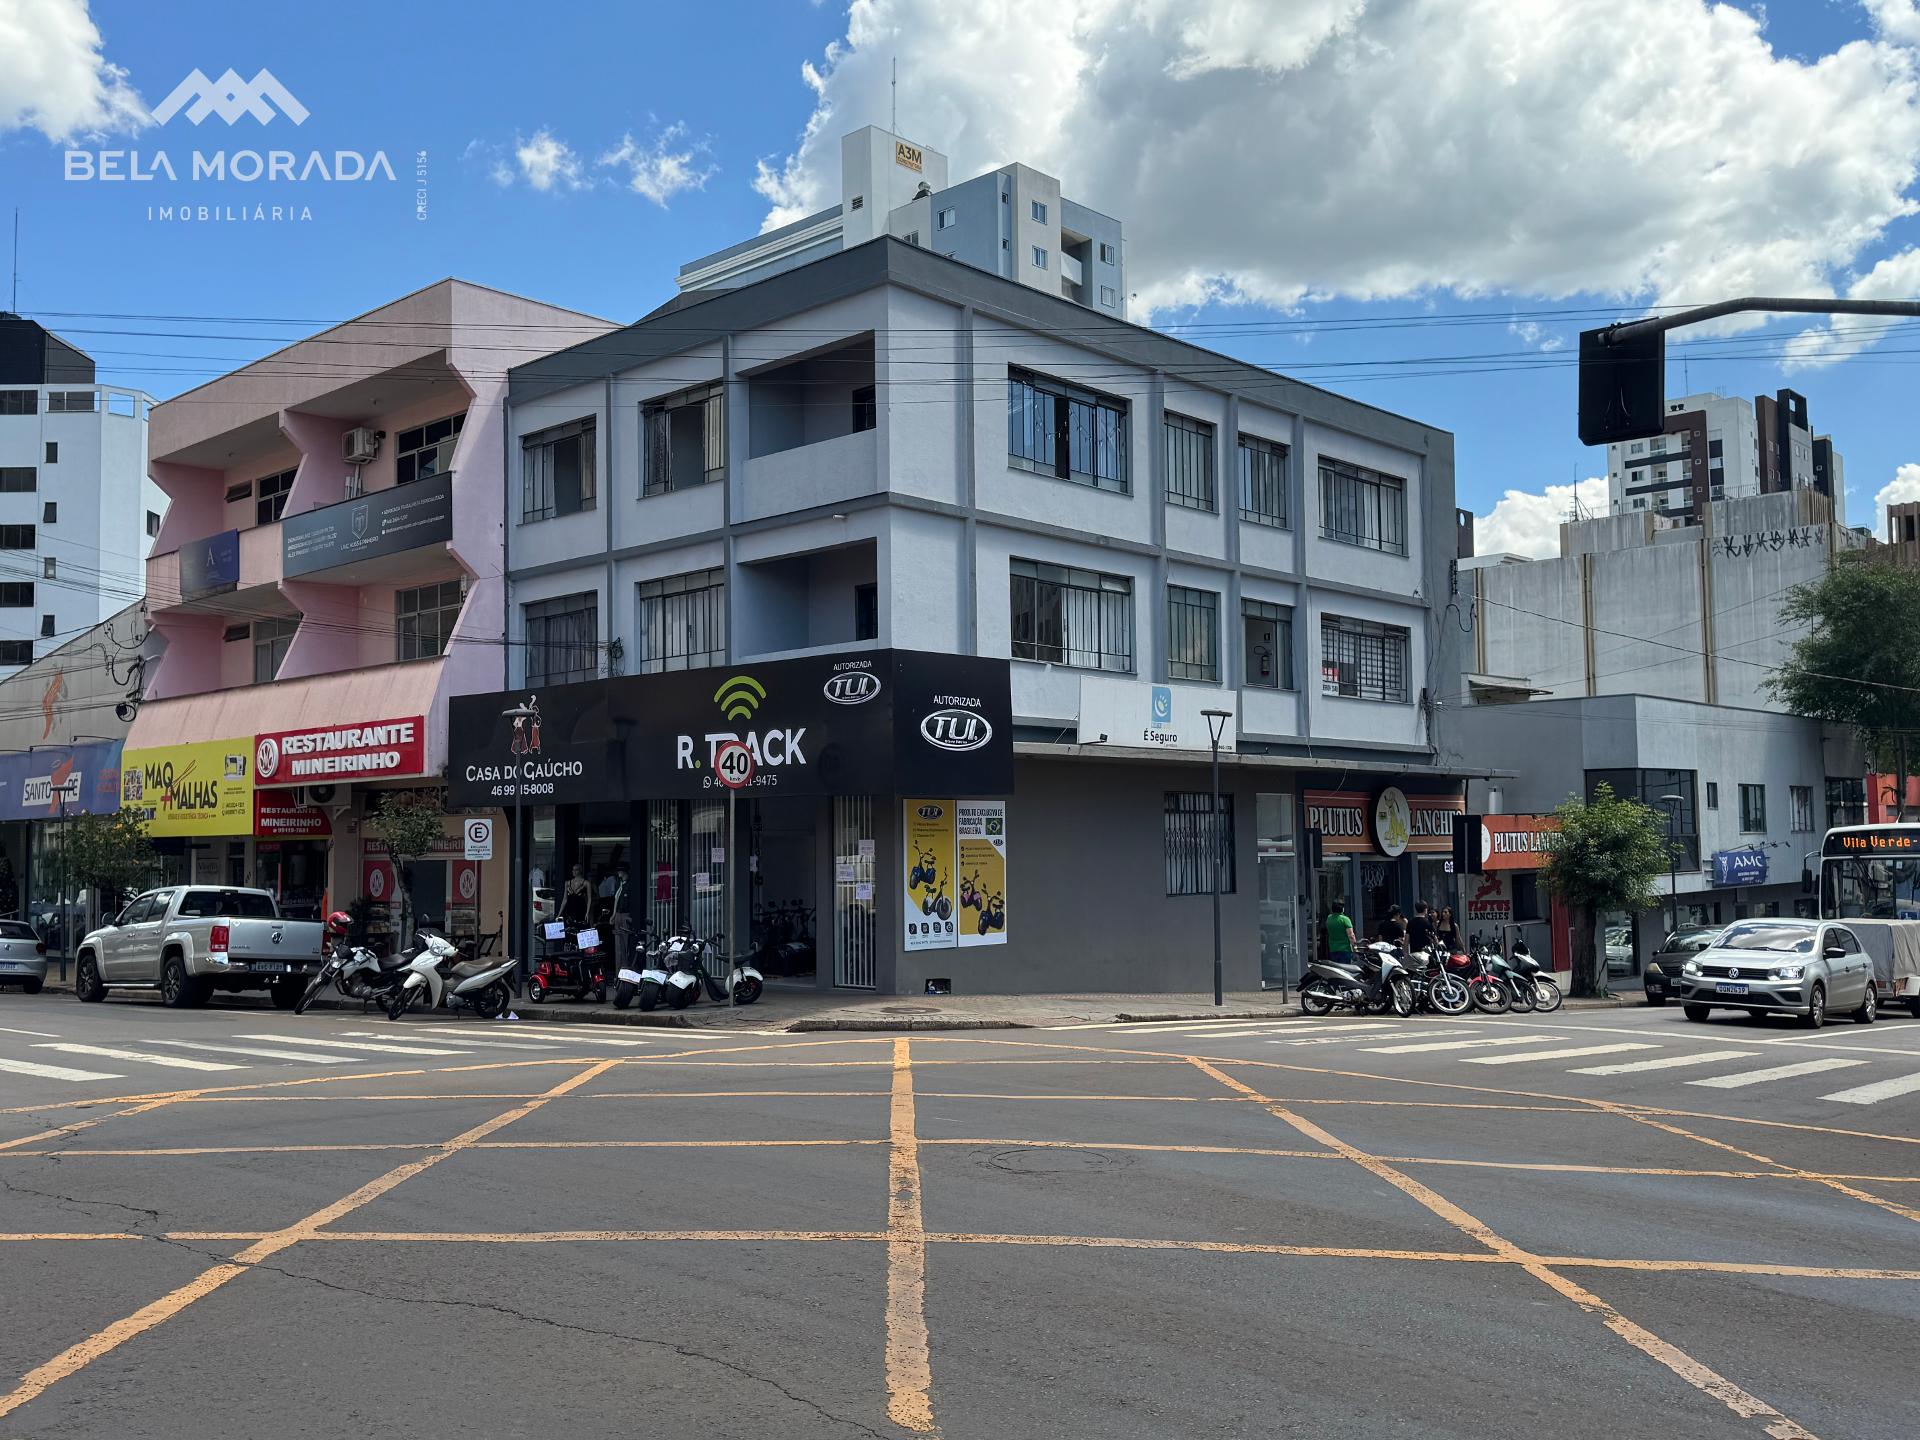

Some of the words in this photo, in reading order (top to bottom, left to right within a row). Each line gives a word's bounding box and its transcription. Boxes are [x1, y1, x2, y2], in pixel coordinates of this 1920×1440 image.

[898, 144, 922, 165] A3M
[833, 660, 873, 671] AUTORIZADA
[933, 695, 982, 708] AUTORIZADA
[281, 722, 415, 755] RESTAURANTE
[1143, 728, 1149, 741] É
[1150, 730, 1178, 745] Seguro
[291, 751, 400, 776] MINEIRINHO
[465, 765, 501, 781] CASA
[523, 758, 583, 781] GAÚCHO
[721, 751, 748, 775] 40
[144, 761, 174, 790] MAQ
[24, 781, 51, 801] SANTO
[491, 785, 503, 796] 46
[503, 783, 554, 796] 9915-8008
[260, 807, 318, 815] RESTAURANTE
[260, 818, 322, 827] MINEIRINHO
[1309, 806, 1364, 836] PLUTUS
[1409, 810, 1463, 836] LANCHE
[474, 827, 483, 839] E
[1494, 832, 1528, 853] PLUTUS
[1843, 837, 1867, 848] Vila
[1870, 836, 1911, 848] Verde
[1733, 855, 1763, 870] AMC
[1468, 912, 1509, 921] LANCHES
